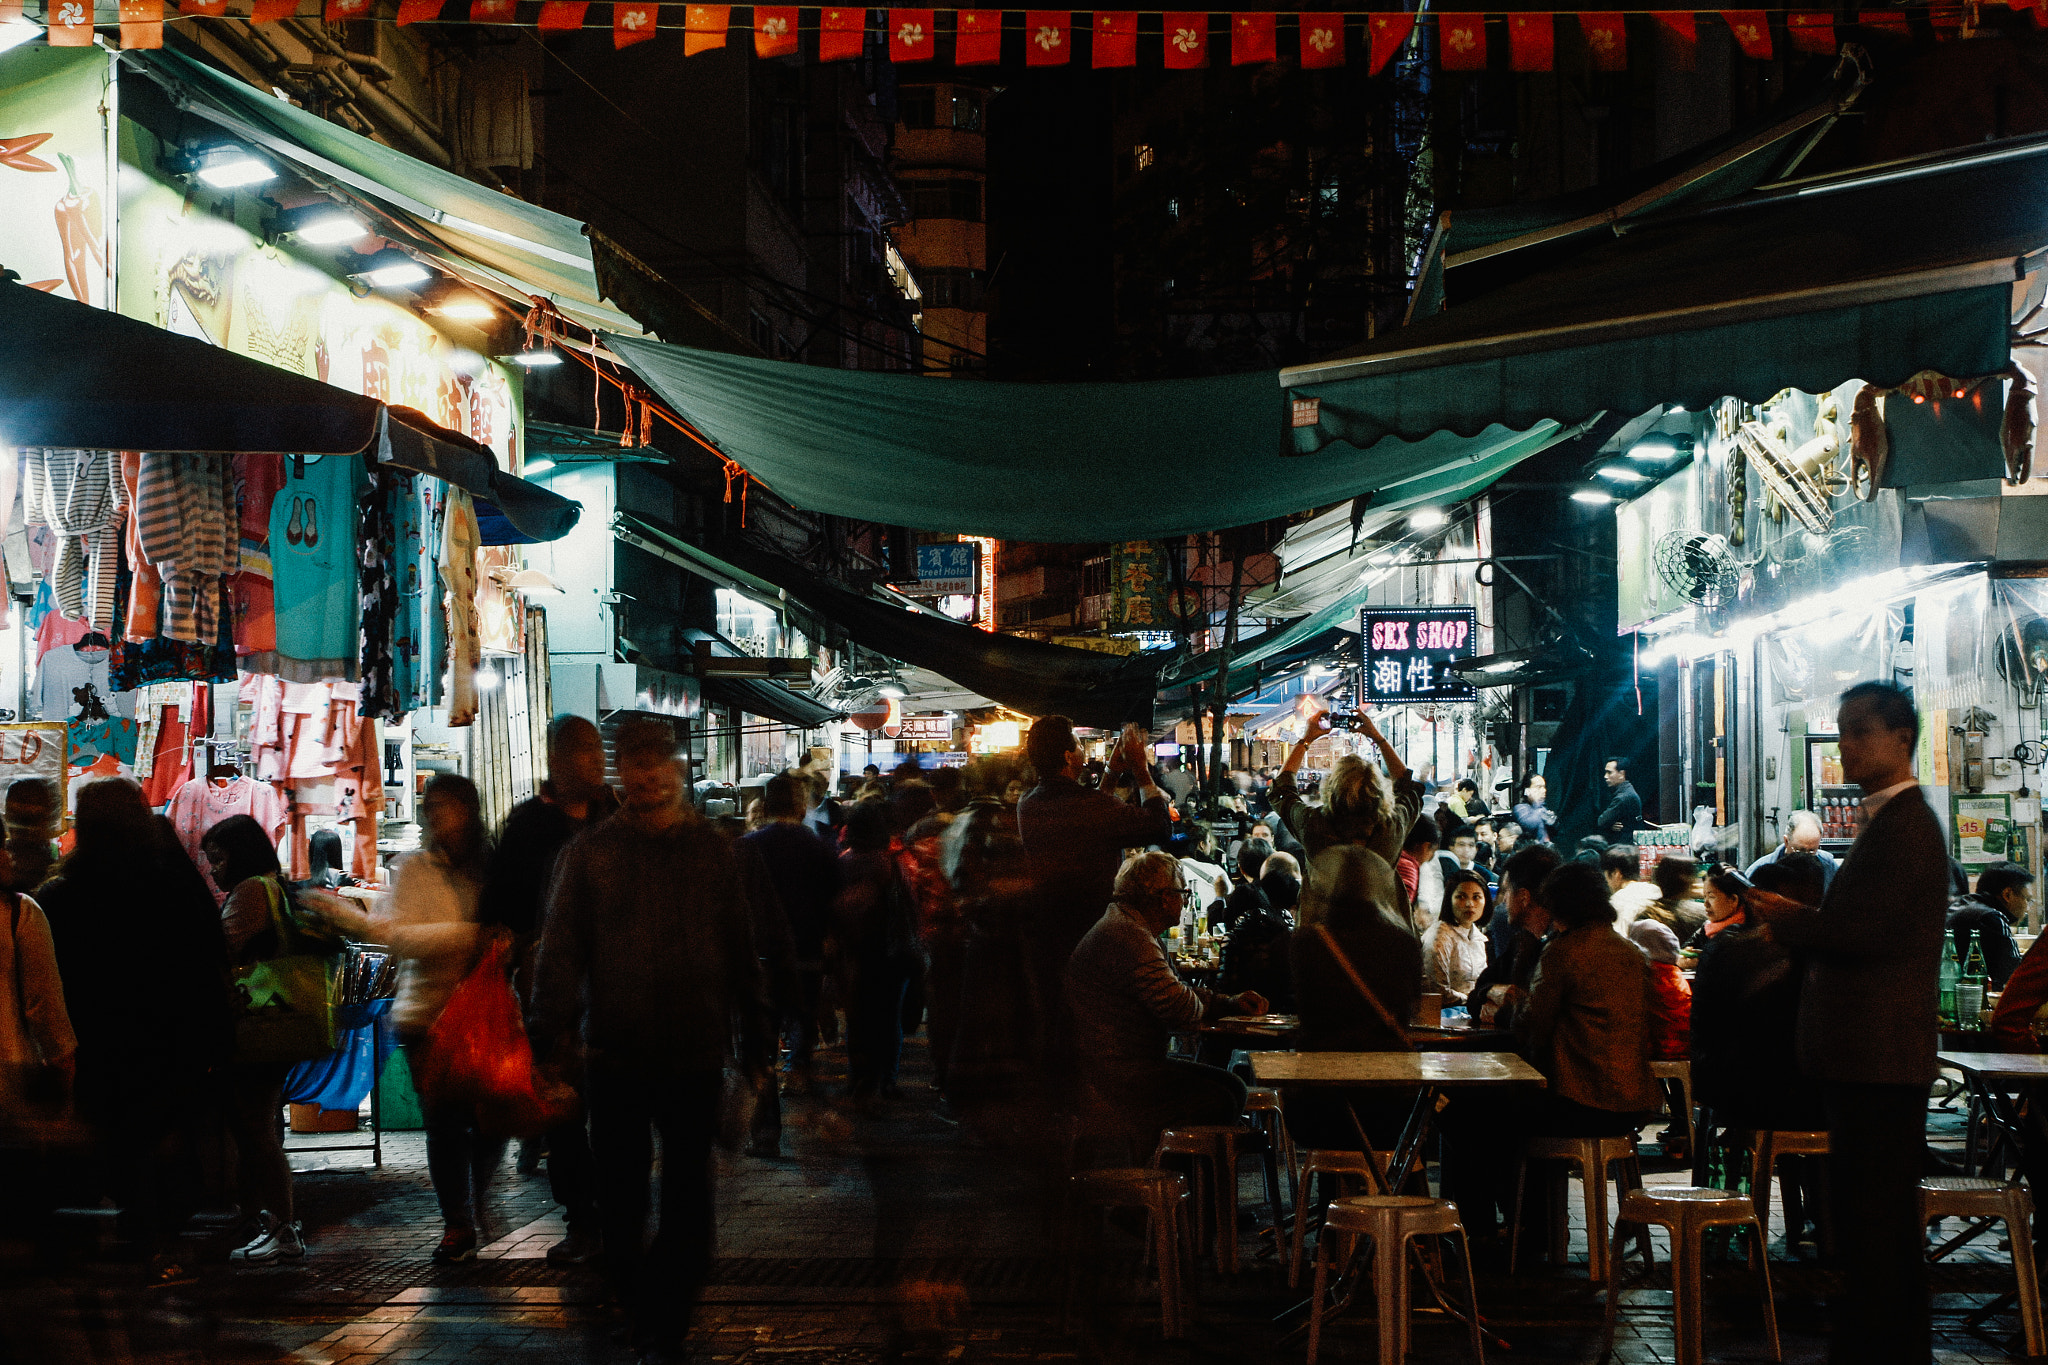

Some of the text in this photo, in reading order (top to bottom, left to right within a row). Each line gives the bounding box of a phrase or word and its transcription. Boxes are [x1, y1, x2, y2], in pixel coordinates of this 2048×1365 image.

[917, 567, 968, 577] Street Hotel
[1372, 620, 1468, 650] SEX SHOP
[1373, 655, 1468, 694] 潮性
